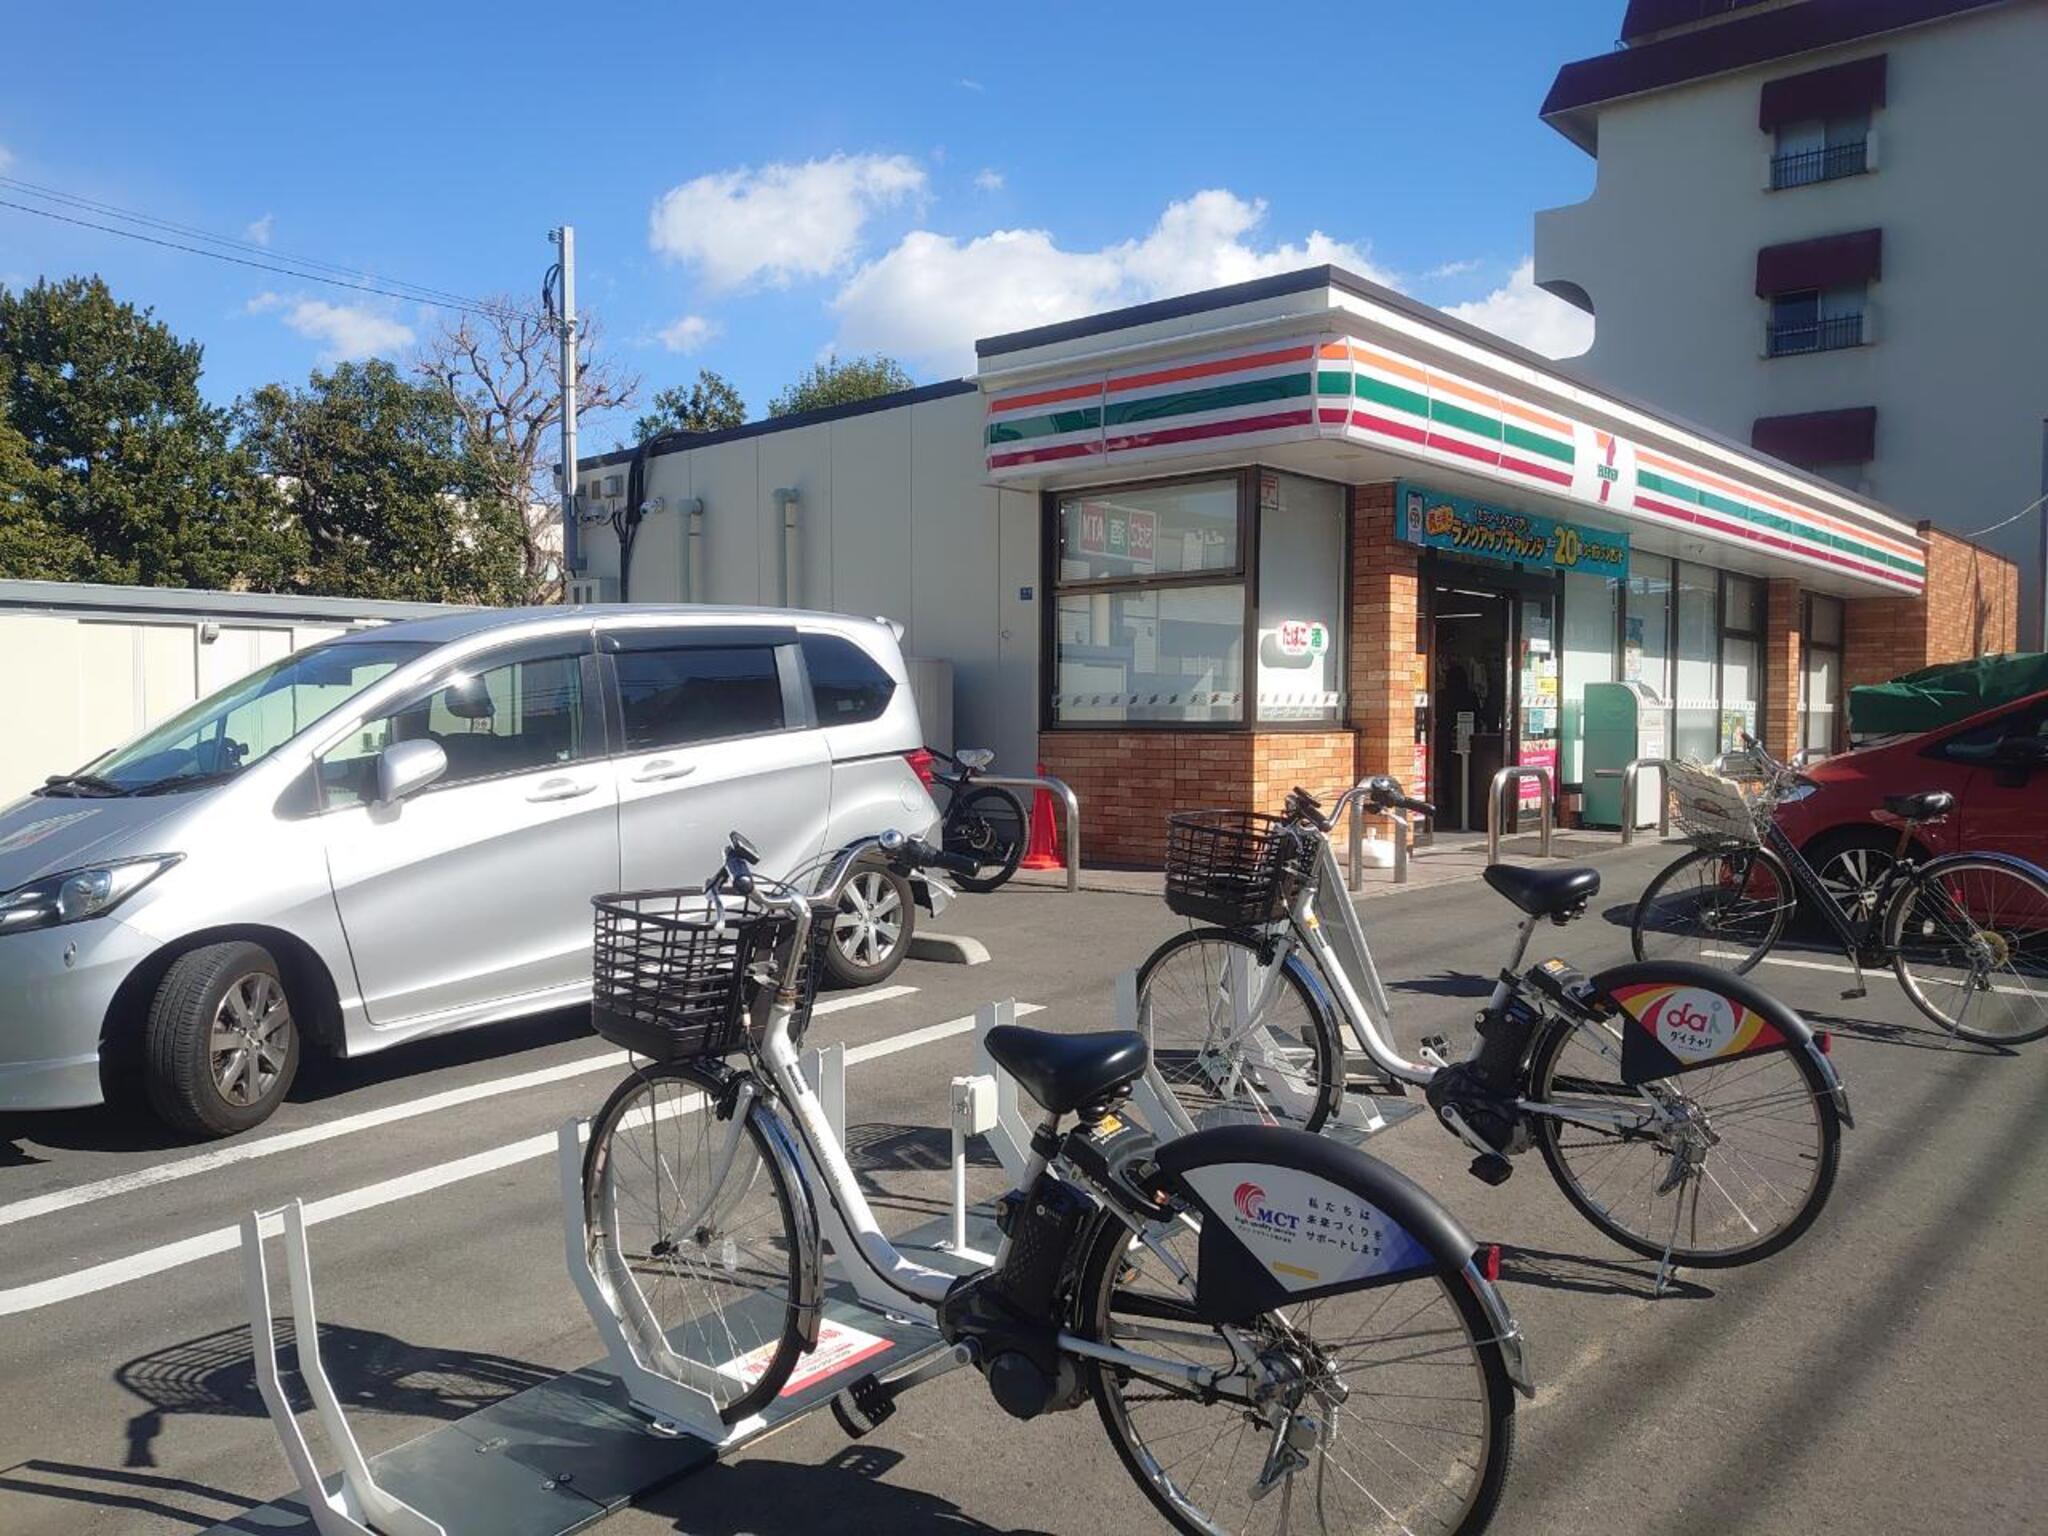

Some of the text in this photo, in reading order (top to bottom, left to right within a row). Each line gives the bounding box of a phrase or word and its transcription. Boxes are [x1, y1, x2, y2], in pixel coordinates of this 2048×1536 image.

[1554, 525, 1578, 566] 20
[1670, 1031, 1713, 1049] ダイチャリ
[1257, 1207, 1300, 1230] MCT
[1308, 1197, 1371, 1221] 私たちは
[1306, 1215, 1383, 1241] 未来づくりを
[1306, 1231, 1383, 1257] サポートします
